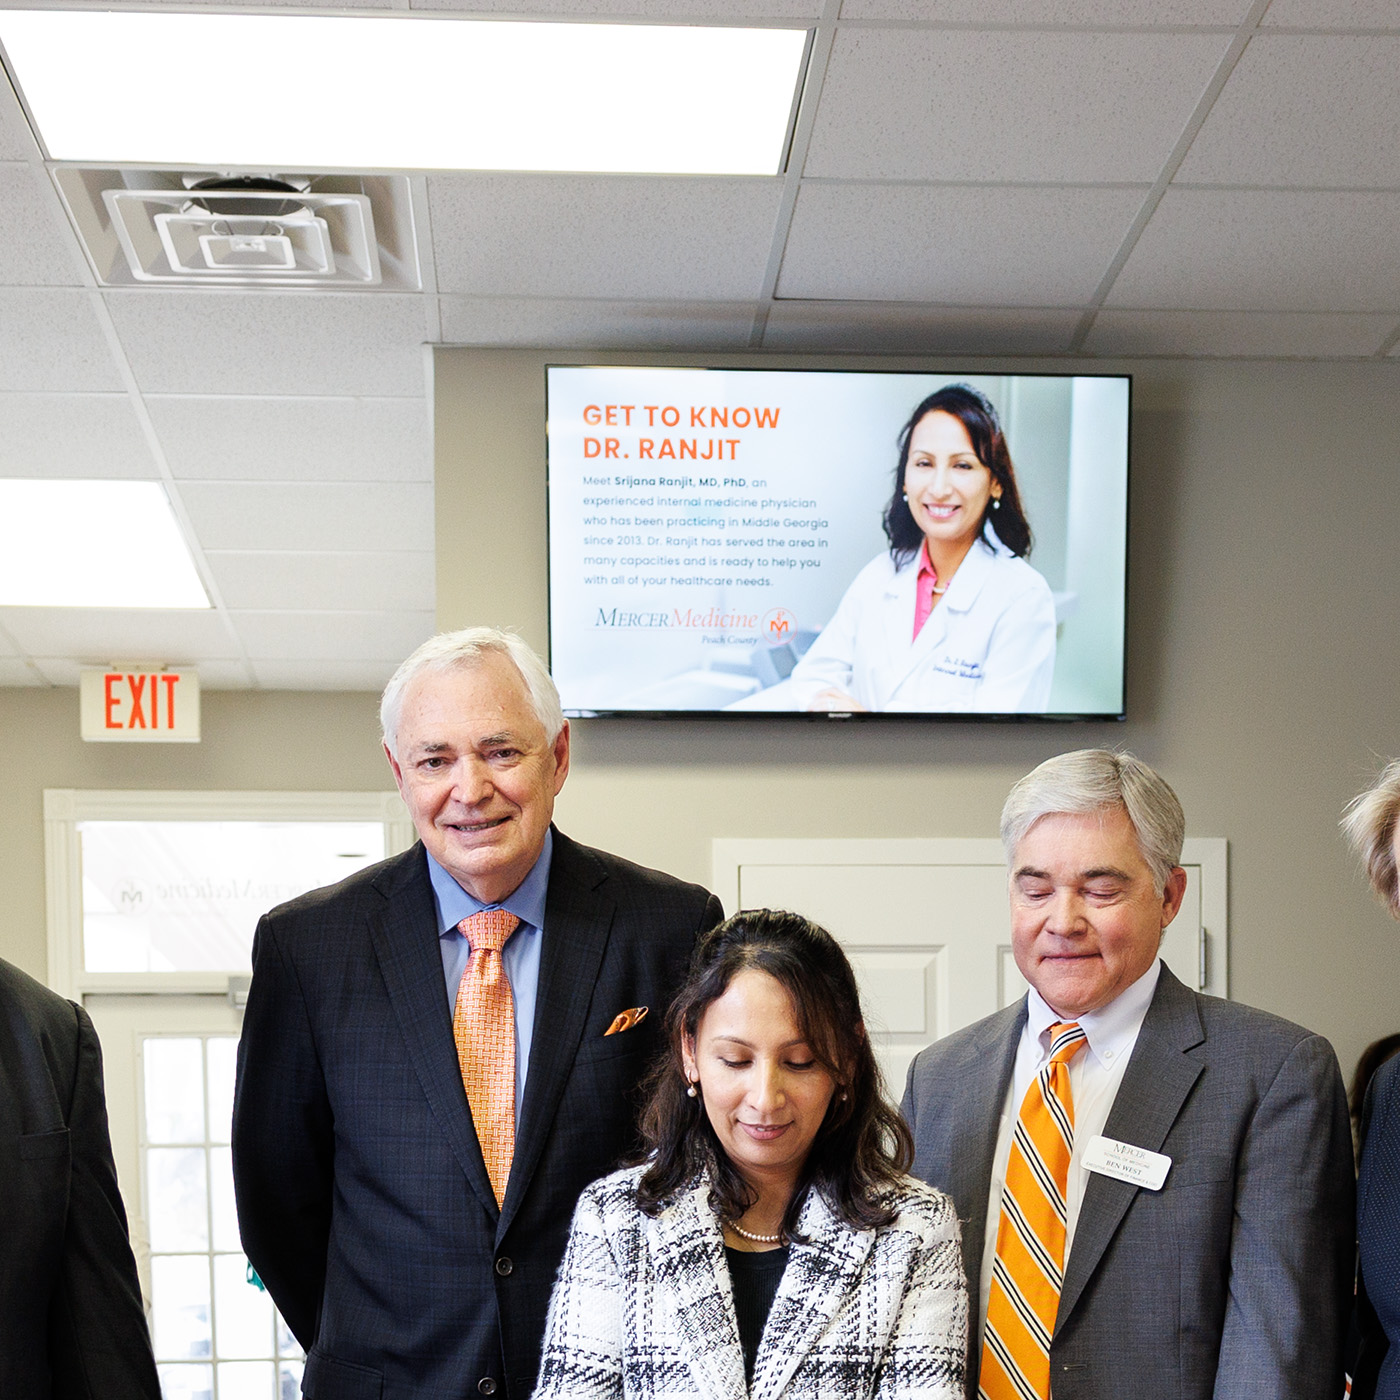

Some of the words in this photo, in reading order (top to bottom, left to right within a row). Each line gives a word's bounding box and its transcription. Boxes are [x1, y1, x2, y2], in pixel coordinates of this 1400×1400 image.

[583, 404, 636, 428] GET
[644, 405, 683, 428] TO
[690, 406, 781, 429] KNOW
[583, 436, 630, 460] DR.
[639, 438, 740, 460] RANJIT
[583, 476, 611, 486] Meet
[615, 476, 656, 488] Srijana
[659, 477, 696, 488] Ranjit,
[699, 478, 720, 488] MD,
[752, 479, 767, 487] an
[583, 497, 653, 507] experienced
[657, 497, 701, 507] internal
[704, 497, 758, 507] medicine
[761, 498, 816, 510] physician
[583, 516, 607, 526] who
[611, 516, 631, 526] has
[635, 516, 663, 526] been
[667, 517, 725, 529] practicing
[729, 518, 739, 527] in
[742, 518, 780, 527] Middle
[783, 519, 828, 530] Georgia
[584, 536, 613, 545] since
[617, 536, 644, 545] 2013.
[648, 537, 662, 546] Dr.
[666, 537, 697, 549] Ranjit
[702, 537, 721, 546] has
[726, 537, 763, 547] served
[767, 538, 785, 547] the
[788, 539, 815, 547] area
[818, 539, 828, 548] in
[584, 557, 617, 567] many
[620, 556, 680, 568] capacities
[684, 557, 706, 566] and
[709, 557, 717, 566] is
[721, 557, 754, 569] ready
[758, 558, 768, 567] to
[772, 558, 796, 569] help
[800, 559, 821, 569] you
[584, 576, 607, 585] with
[611, 576, 624, 585] all
[628, 576, 638, 585] of
[642, 577, 667, 587] your
[671, 576, 732, 586] healthcare
[736, 577, 774, 586] needs.
[702, 635, 725, 645] Peach
[727, 635, 759, 646] County
[105, 674, 180, 730] EXIT
[1113, 1143, 1146, 1159] MERCER
[1106, 1160, 1121, 1169] BEN
[1123, 1165, 1142, 1176] WEST
